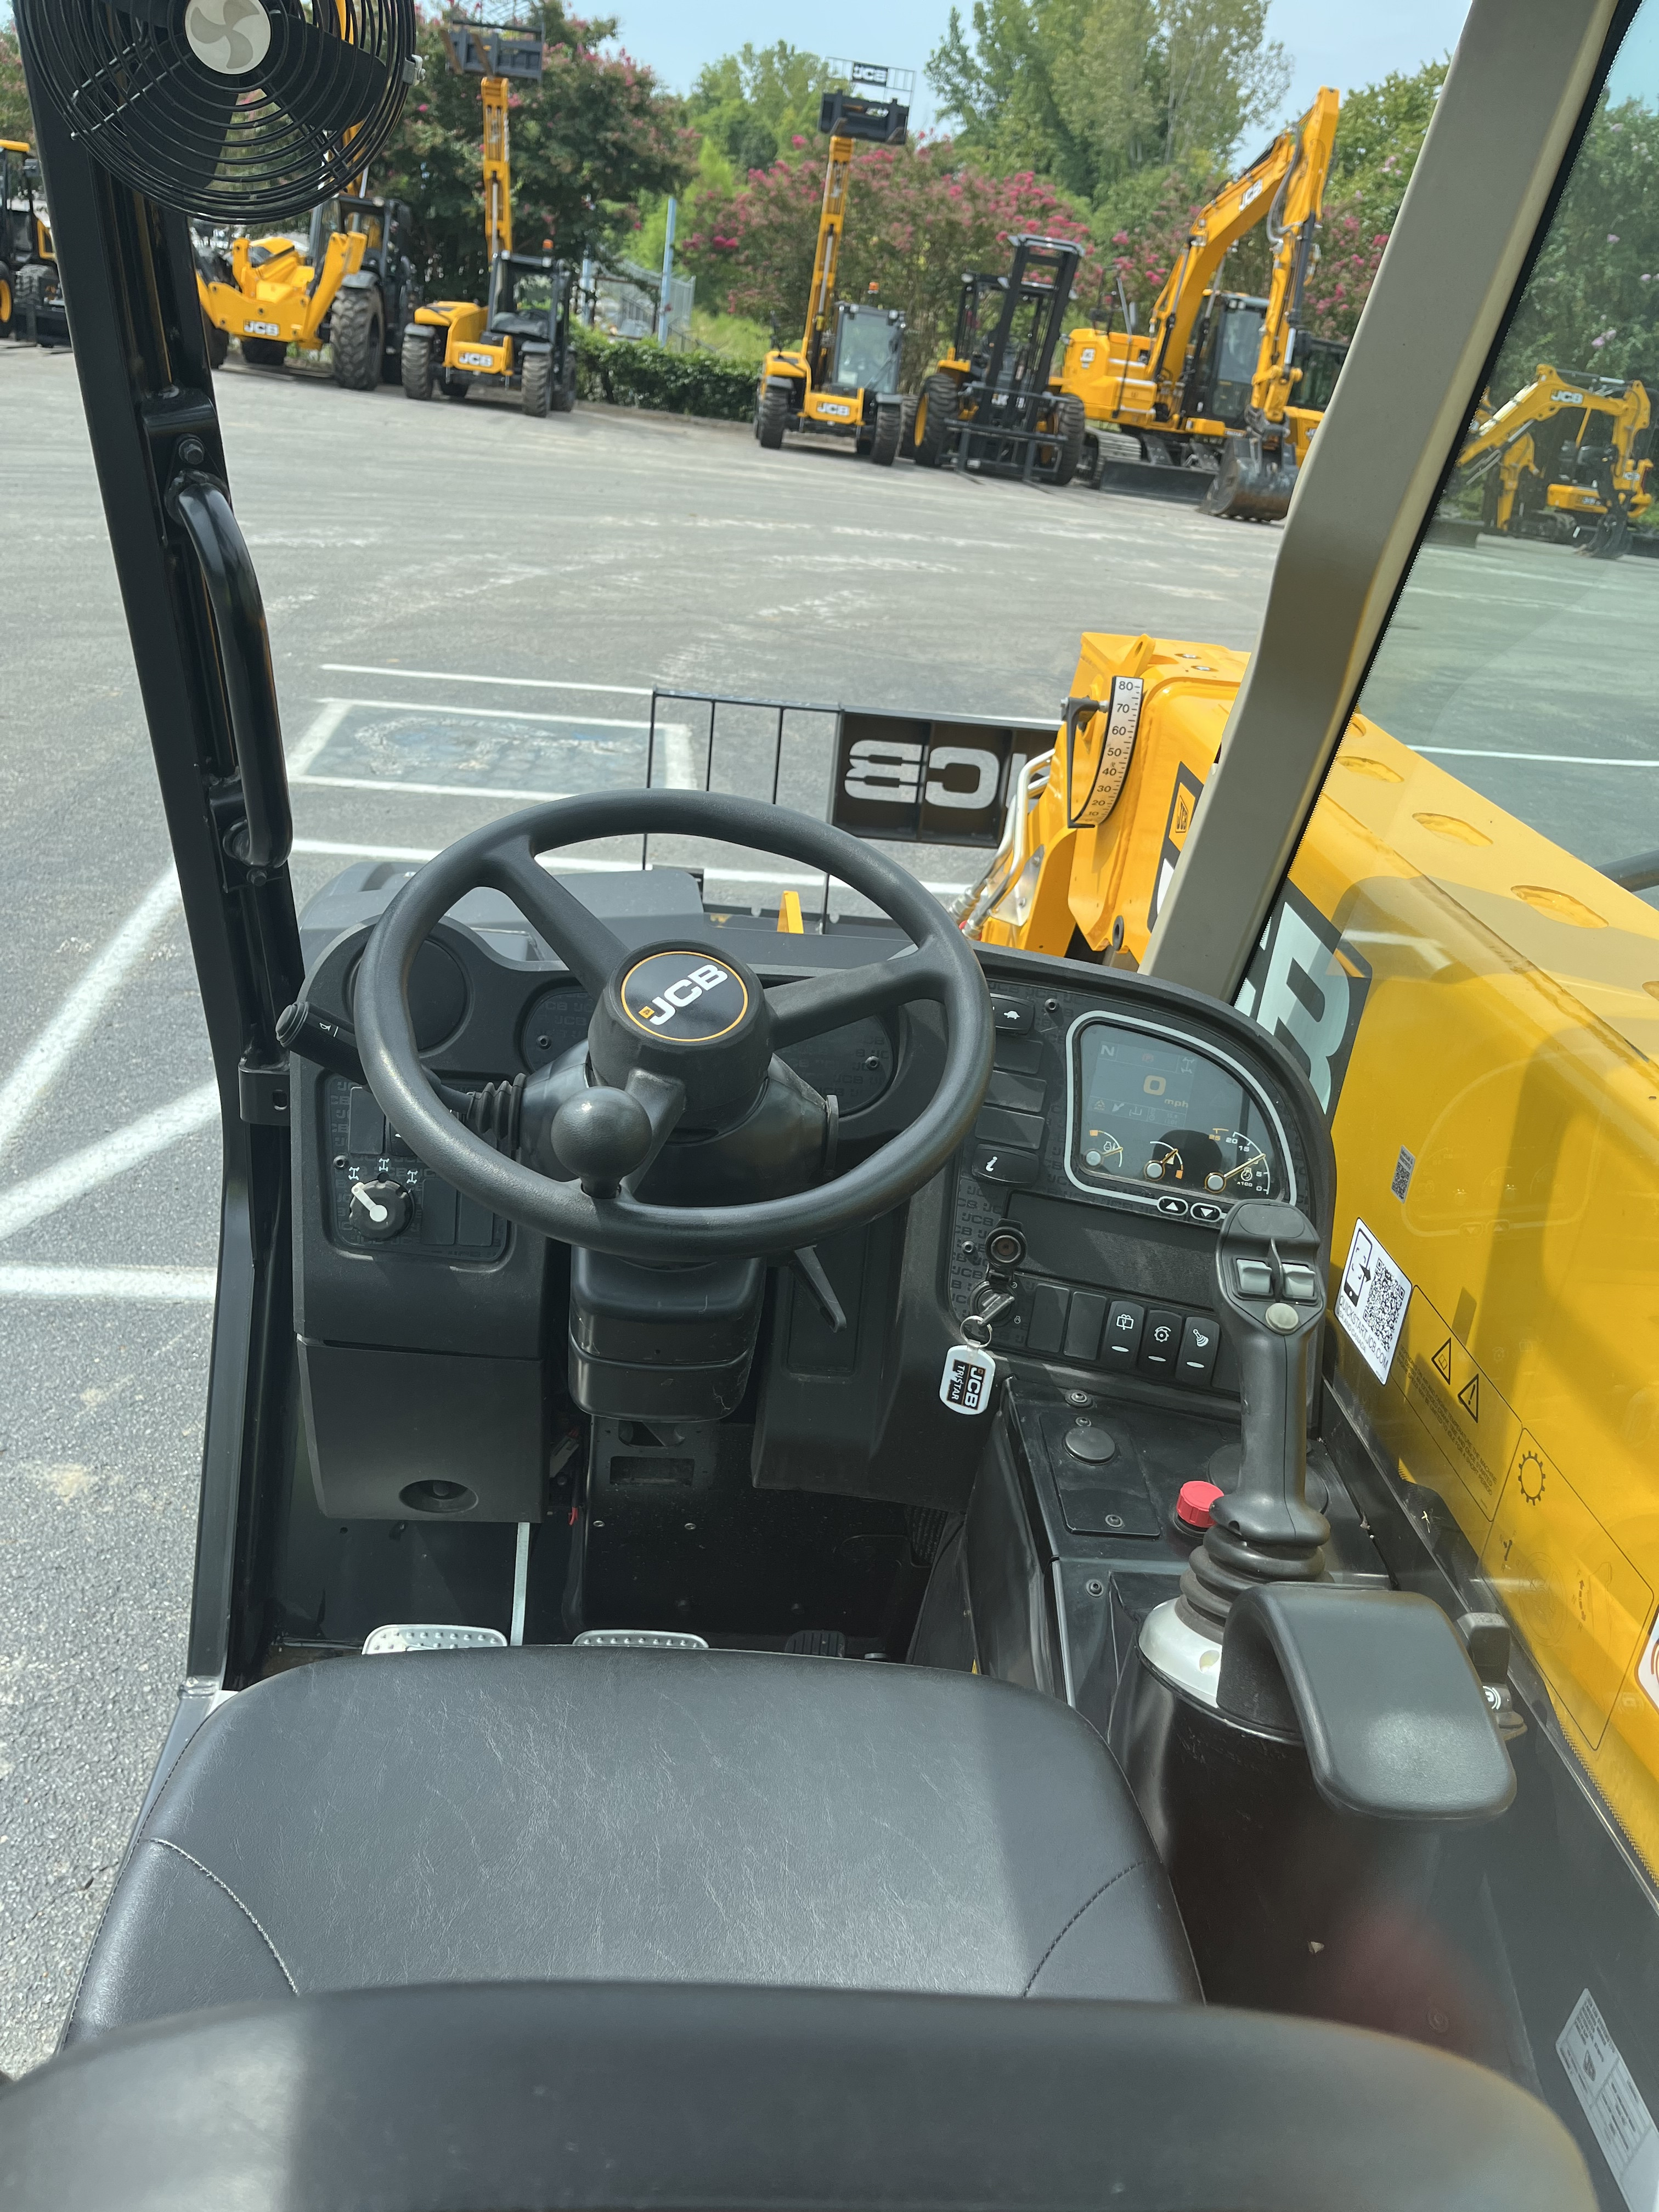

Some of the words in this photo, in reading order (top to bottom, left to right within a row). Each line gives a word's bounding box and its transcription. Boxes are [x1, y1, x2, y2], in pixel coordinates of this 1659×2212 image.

[853, 64, 887, 83] JCB
[1239, 178, 1263, 212] JCB
[244, 320, 279, 336] JCB
[459, 352, 493, 367] JCB
[1551, 390, 1583, 404] JCB
[817, 402, 850, 416] JCB
[1119, 681, 1133, 691] 80
[1117, 703, 1130, 713] 70
[1112, 726, 1126, 736] 60
[1107, 748, 1121, 757] 50
[649, 964, 728, 1025] JCB
[1100, 1045, 1115, 1057] N
[1143, 1075, 1167, 1096] 0
[1164, 1098, 1189, 1109] mph
[962, 1212, 994, 1227] JCB
[952, 1265, 984, 1279] JCB
[1339, 1295, 1389, 1370] QUICKSTART.JCB.COM
[1344, 1320, 1352, 1331] AND
[1351, 1329, 1366, 1353] CANADA
[951, 1365, 965, 1400] TRISTAR
[964, 1367, 982, 1407] JCB
[1448, 1412, 1472, 1449] TEMPERATURE
[1457, 1435, 1465, 1449] AND
[1475, 1460, 1493, 1487] STARTED
[1465, 1455, 1479, 1476] SHORT
[1477, 1472, 1493, 1497] PERIOD
